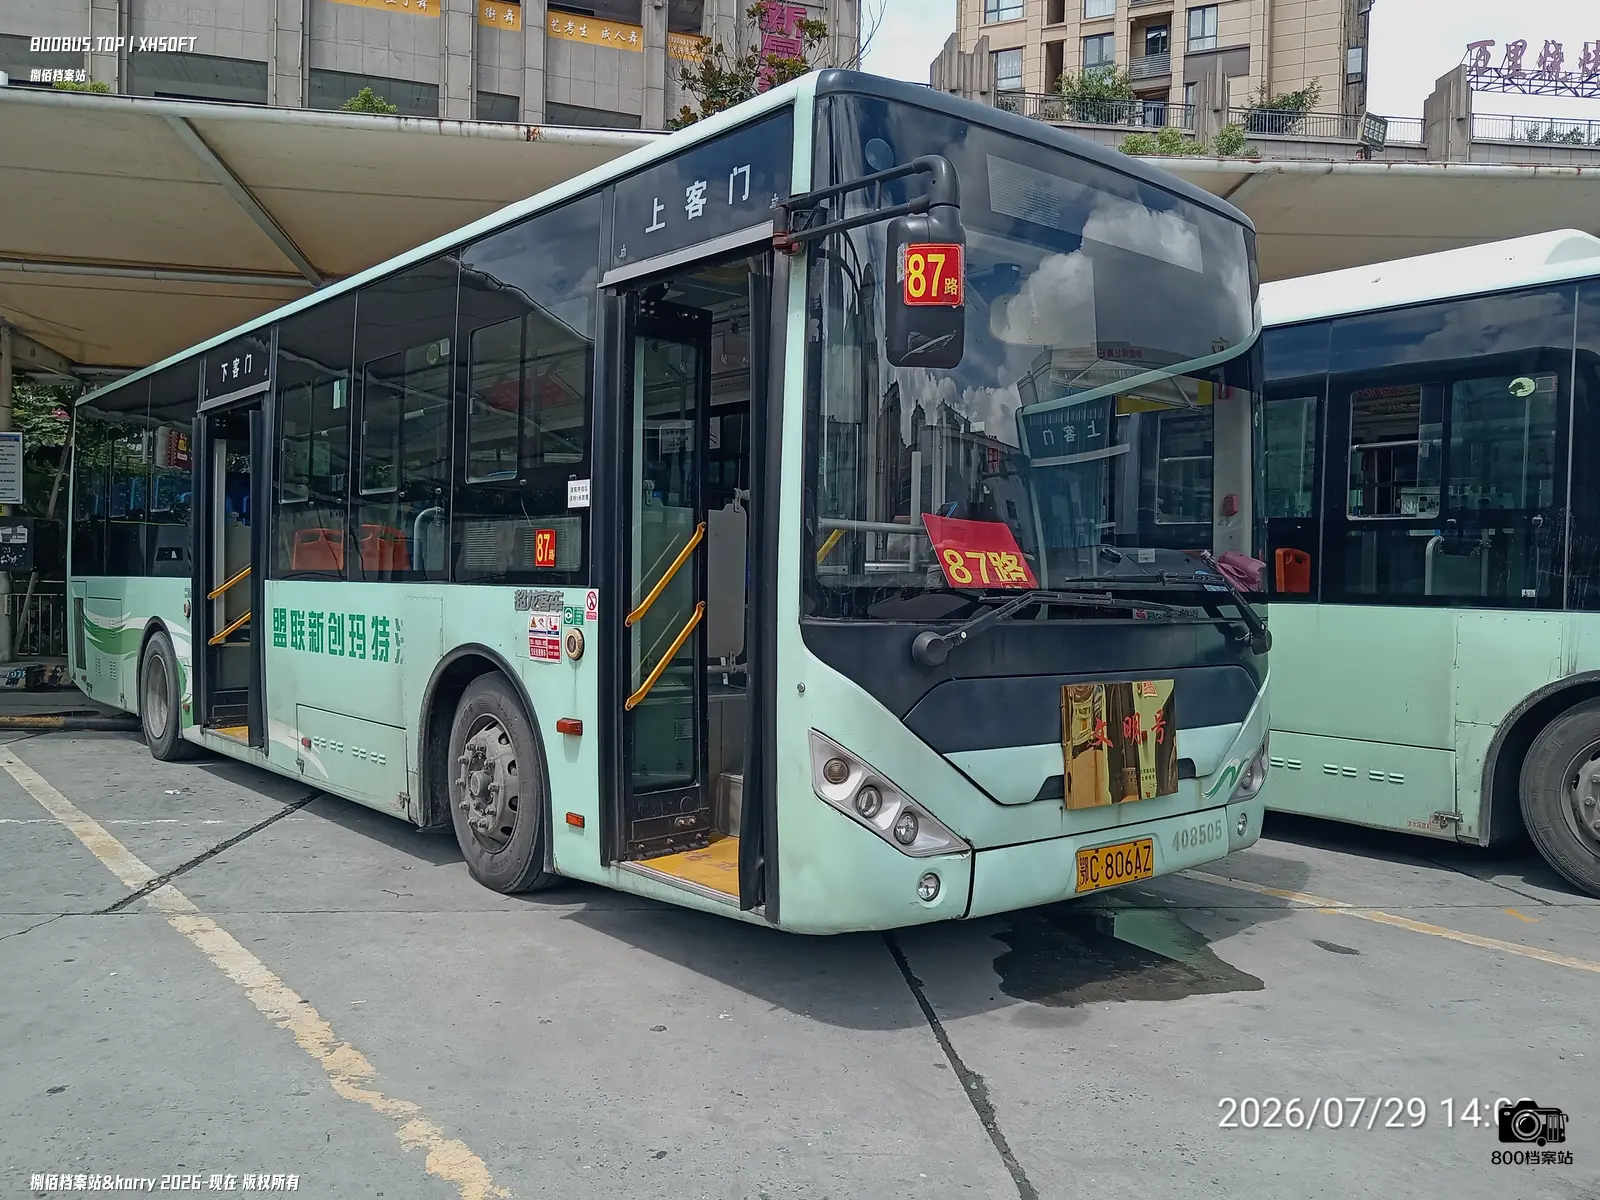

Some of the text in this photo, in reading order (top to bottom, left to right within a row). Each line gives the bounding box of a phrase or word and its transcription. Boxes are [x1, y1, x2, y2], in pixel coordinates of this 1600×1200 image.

[484, 7, 515, 25] 街舞
[550, 18, 638, 46] 艺考生 成人舞
[645, 164, 751, 234] 上客门
[908, 253, 958, 298] 87路
[221, 353, 252, 383] 下客门
[537, 533, 554, 562] 87路
[943, 549, 1028, 584] 87路
[1090, 708, 1166, 748] 文明号
[1172, 819, 1222, 851] 408505
